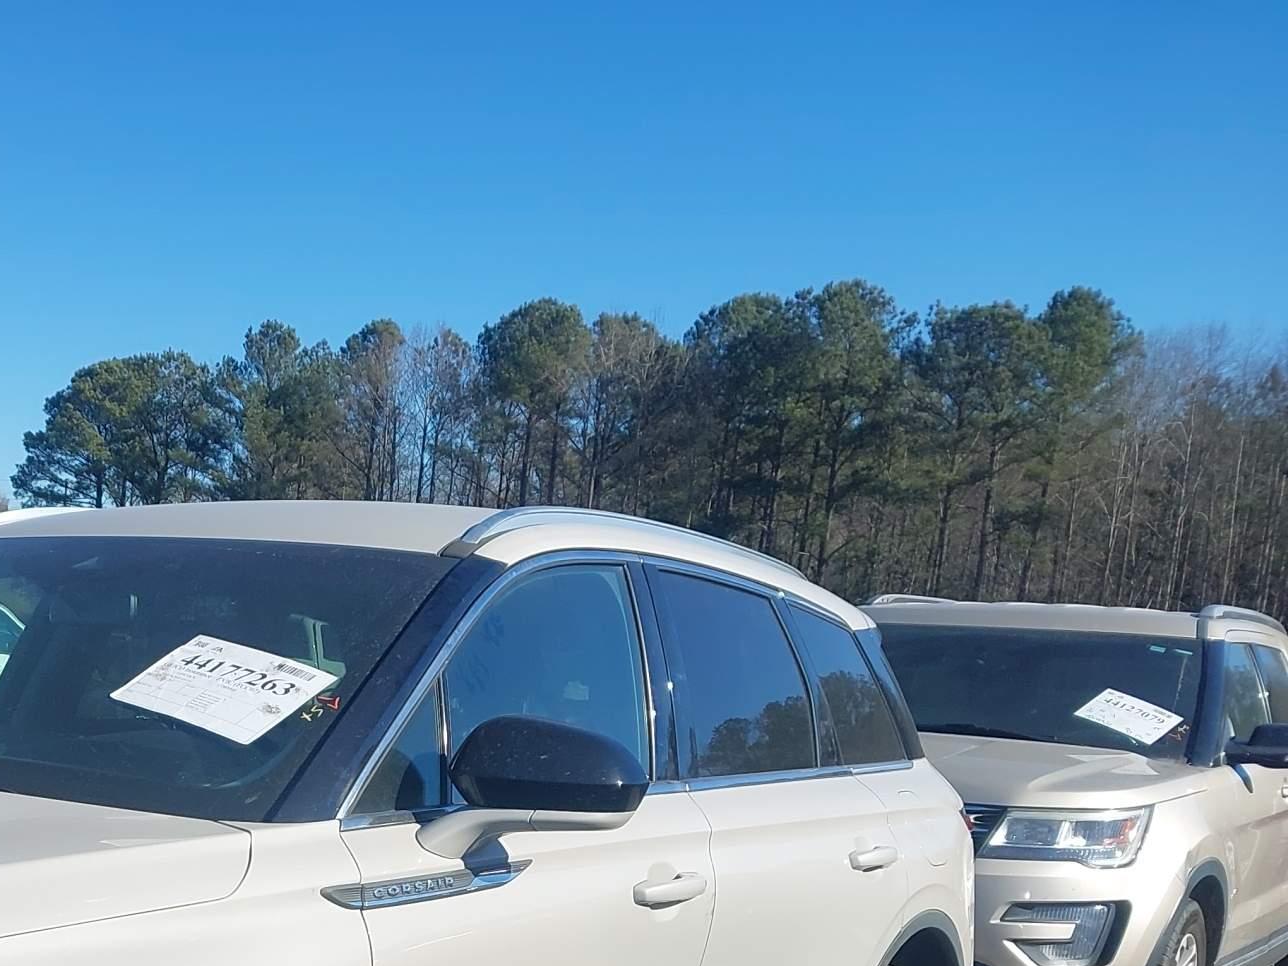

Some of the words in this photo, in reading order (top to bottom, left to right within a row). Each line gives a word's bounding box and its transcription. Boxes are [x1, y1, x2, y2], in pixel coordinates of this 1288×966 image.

[180, 654, 295, 696] 44177263
[1103, 697, 1166, 724] 44127079
[372, 876, 455, 898] CORSAIR
